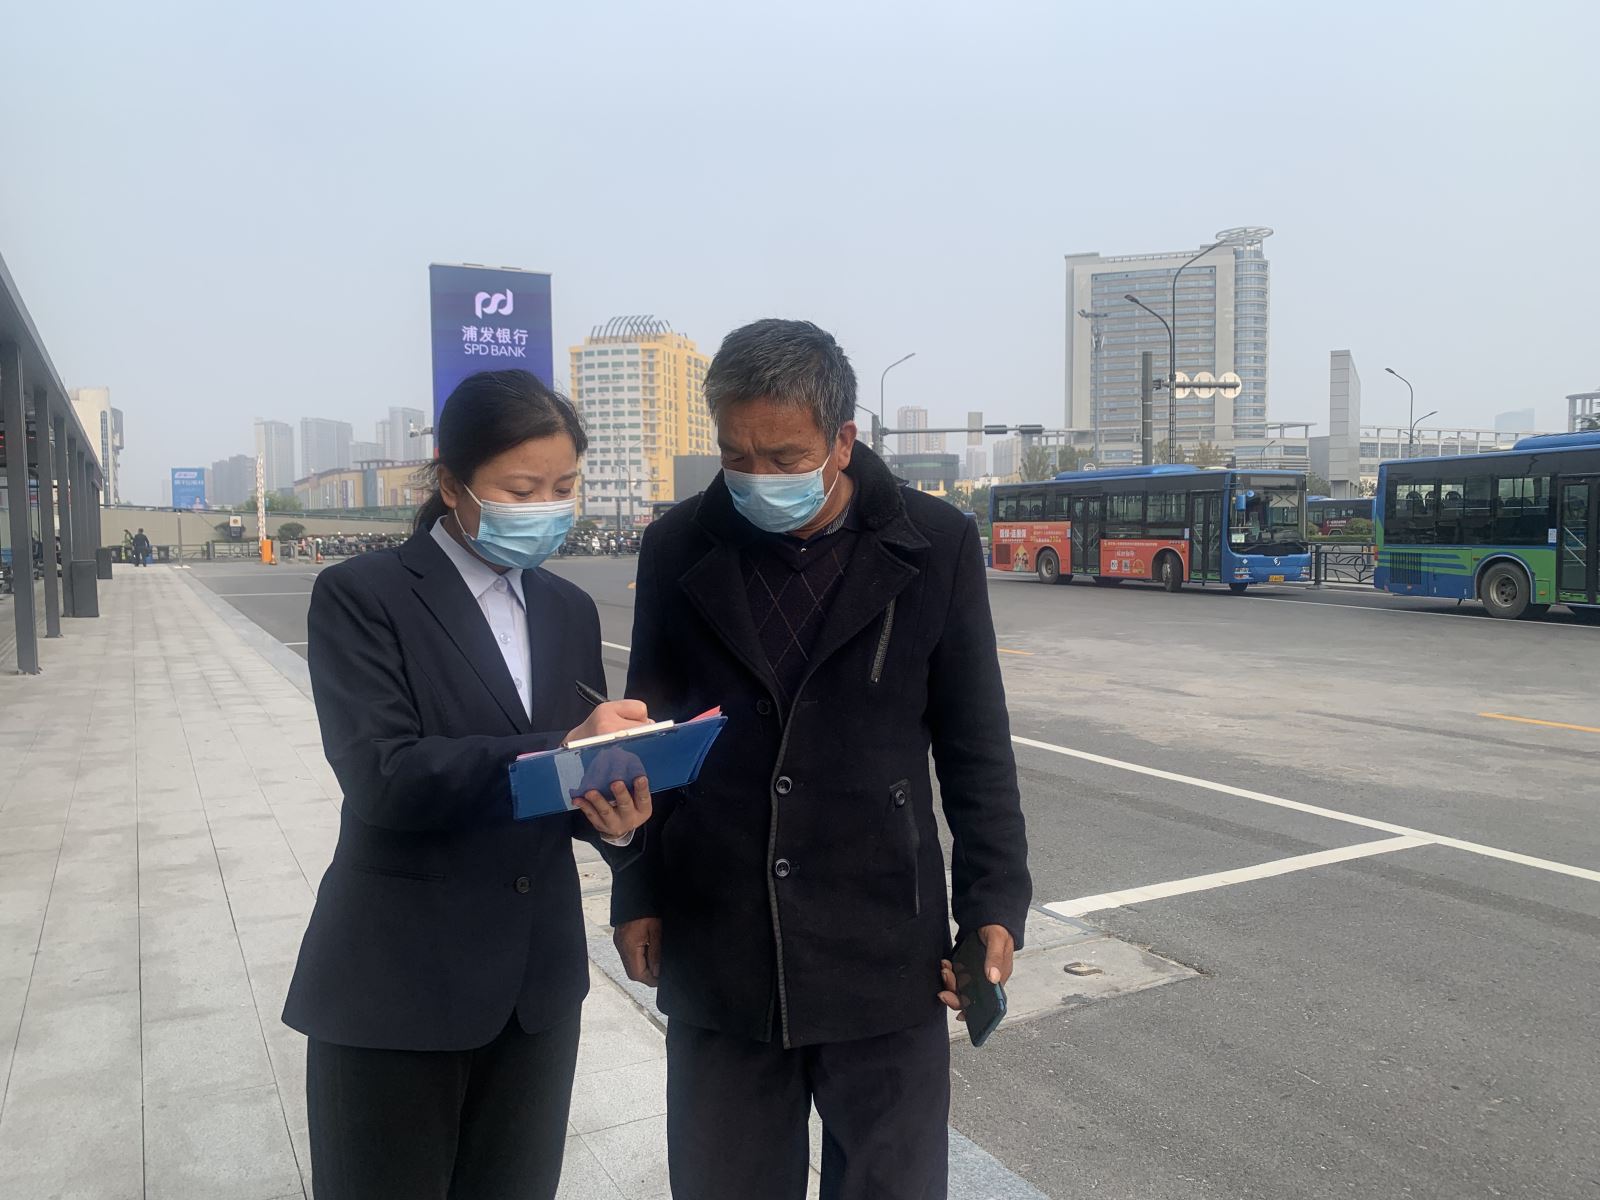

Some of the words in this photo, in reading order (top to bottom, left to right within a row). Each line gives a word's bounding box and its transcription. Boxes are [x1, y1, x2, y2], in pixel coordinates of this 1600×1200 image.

[462, 325, 529, 345] 浦发银行
[464, 343, 489, 356] SPD
[491, 346, 526, 358] BANK
